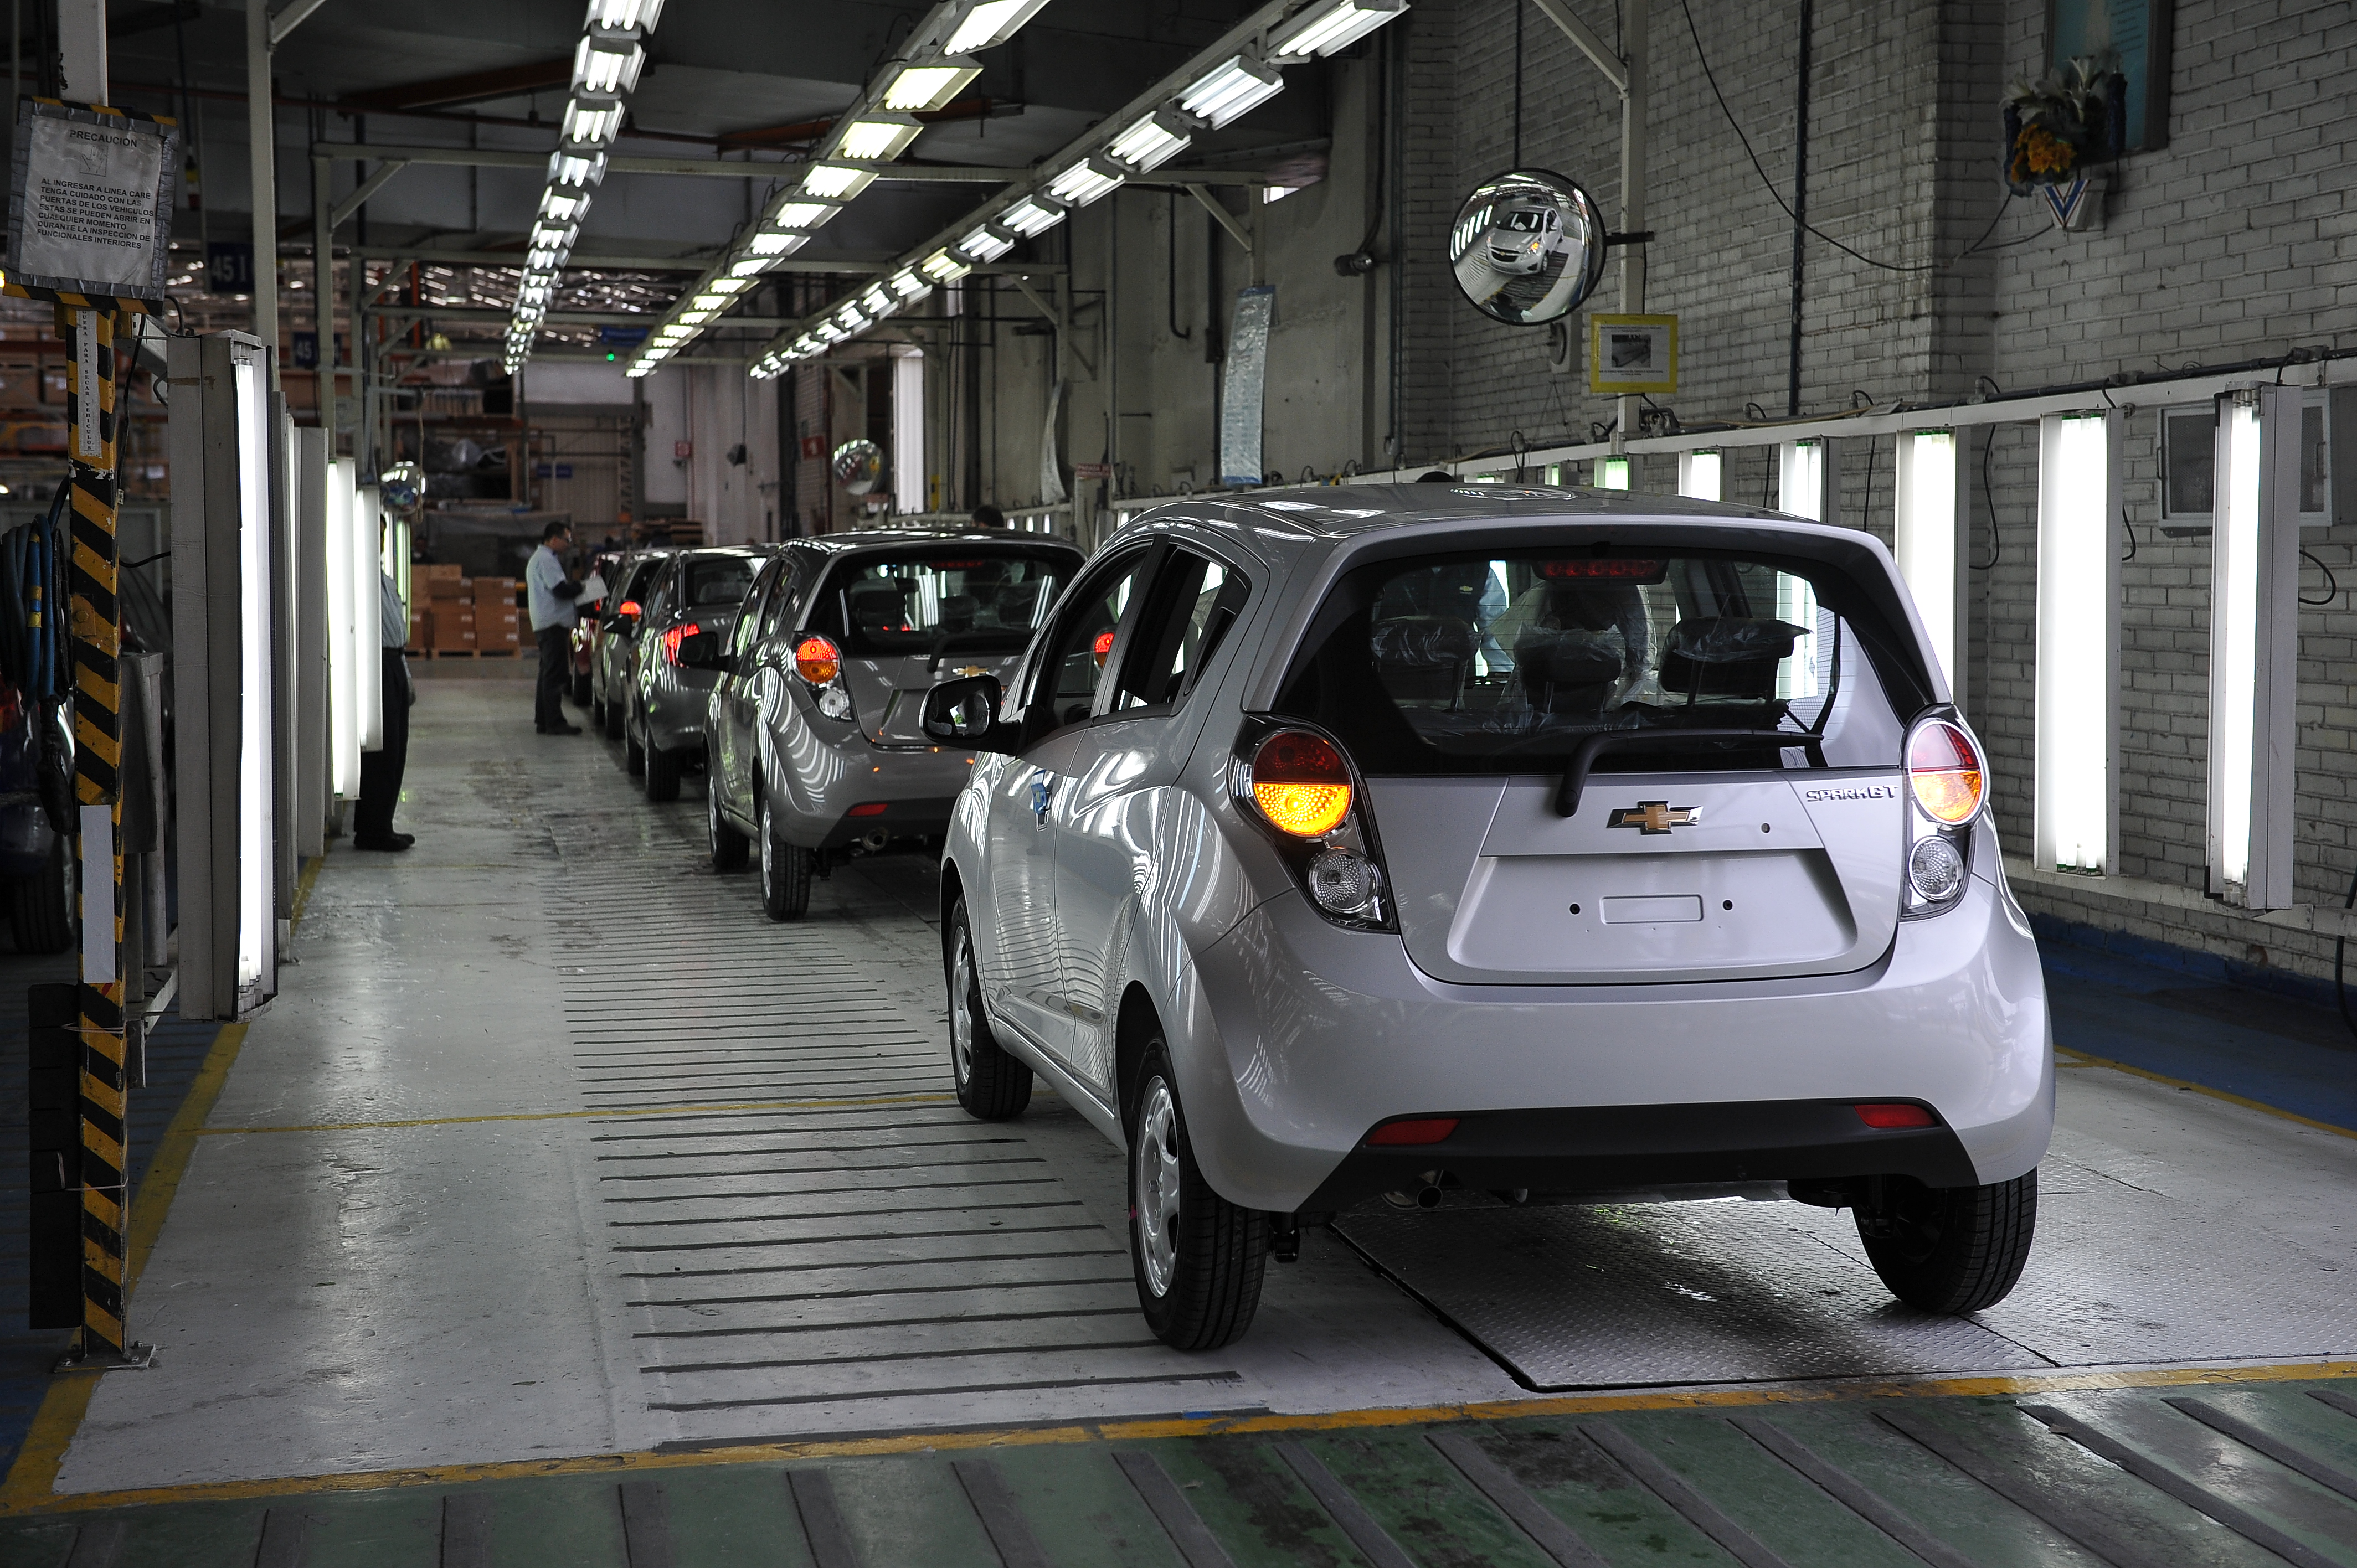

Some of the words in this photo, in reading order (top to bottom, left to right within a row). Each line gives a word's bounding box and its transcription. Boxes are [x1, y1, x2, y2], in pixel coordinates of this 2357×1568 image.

[40, 187, 67, 195] TENGA
[69, 190, 105, 201] CUIDADO
[107, 196, 125, 204] CON
[53, 179, 94, 192] INGRESAR
[104, 187, 127, 196] LINEA
[129, 191, 151, 199] CARE
[39, 204, 65, 213] ESTAS
[79, 209, 111, 219] PUEDEN
[114, 214, 138, 223] ABRIR
[40, 195, 77, 205] PUERTAS
[110, 205, 153, 216] VEHICULOS
[37, 221, 75, 231] DURANTE
[90, 228, 137, 240] INSPECCION
[38, 212, 84, 224] CUALQUIER
[86, 219, 127, 230] MOMENTO
[37, 229, 92, 242] FUNCIONALES
[95, 236, 141, 249] INTERIORES
